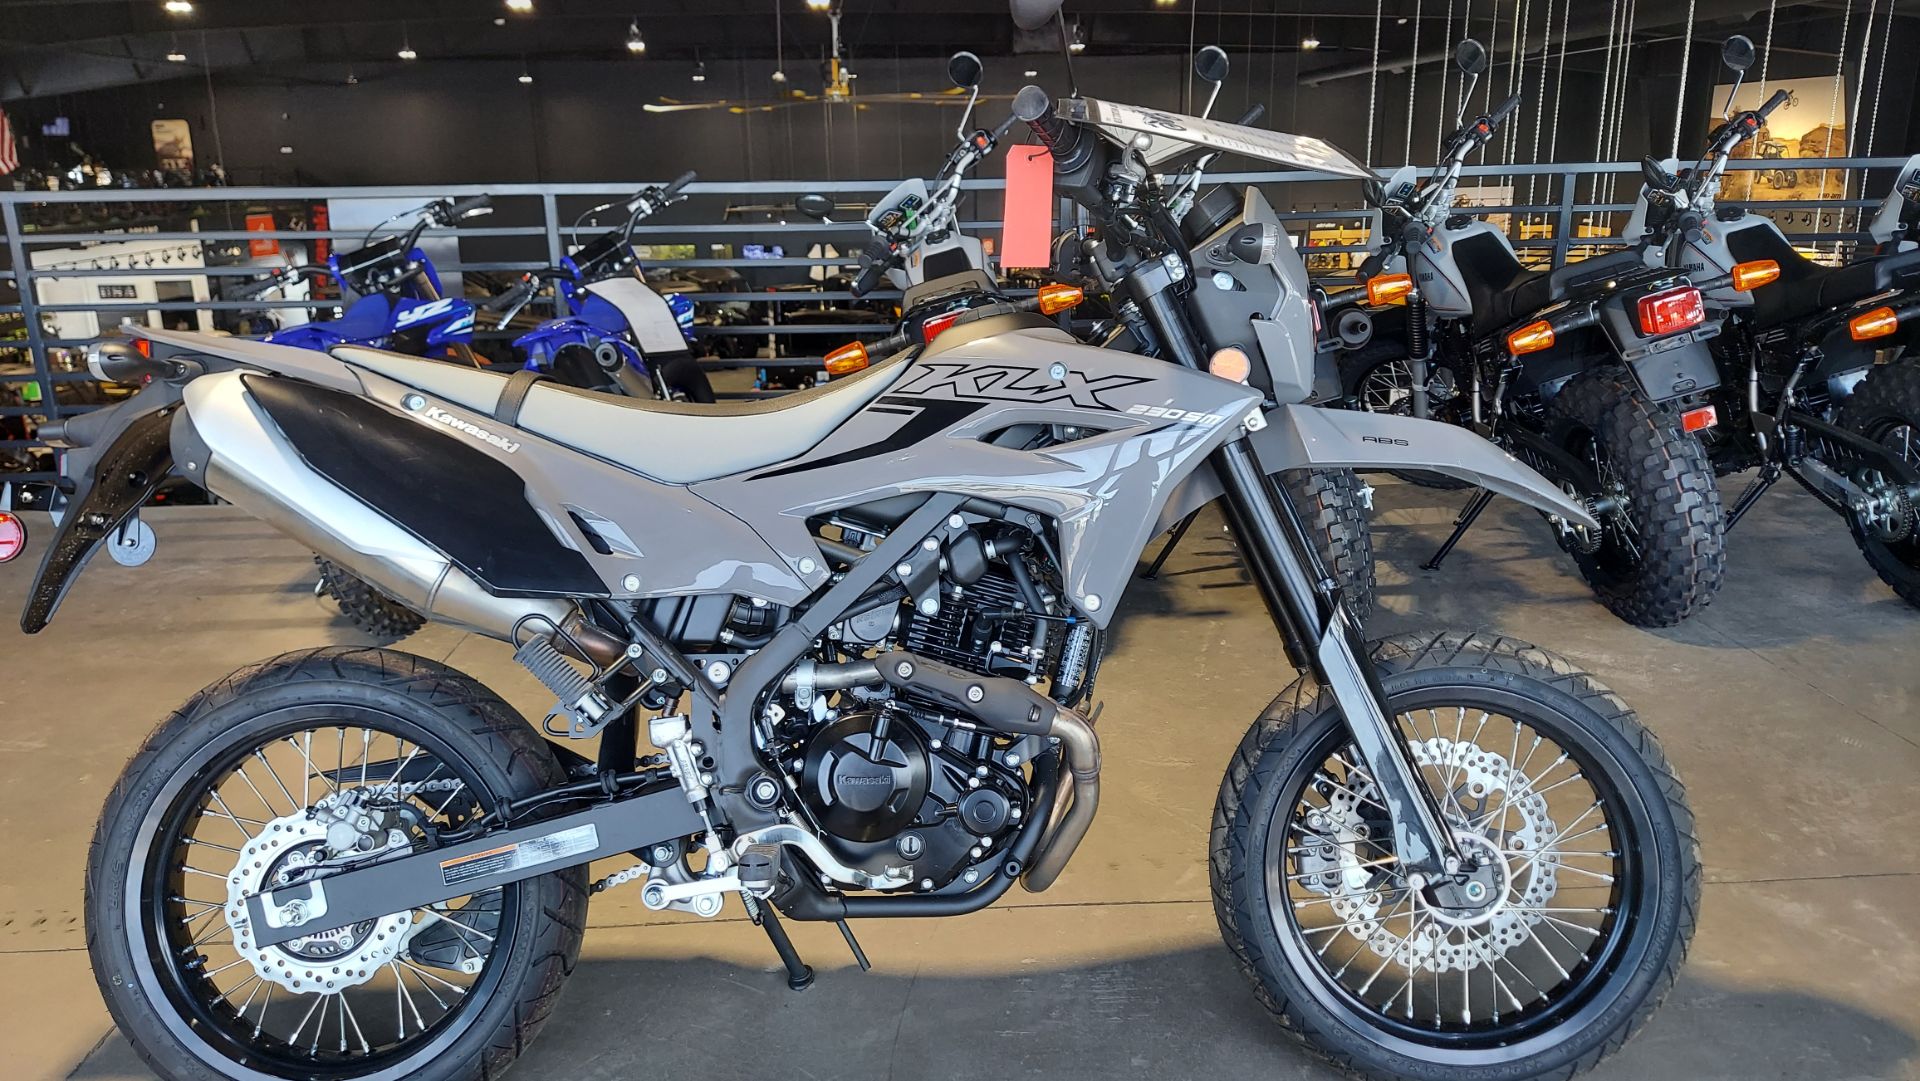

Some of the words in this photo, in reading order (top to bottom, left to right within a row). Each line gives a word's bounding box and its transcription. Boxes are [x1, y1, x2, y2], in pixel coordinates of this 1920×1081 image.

[395, 298, 453, 328] YZ
[893, 363, 1157, 412] KLX
[1125, 404, 1224, 427] 230SM
[425, 407, 520, 454] Kawasaki
[1362, 436, 1409, 447] ABS
[838, 774, 891, 786] Kawasaki
